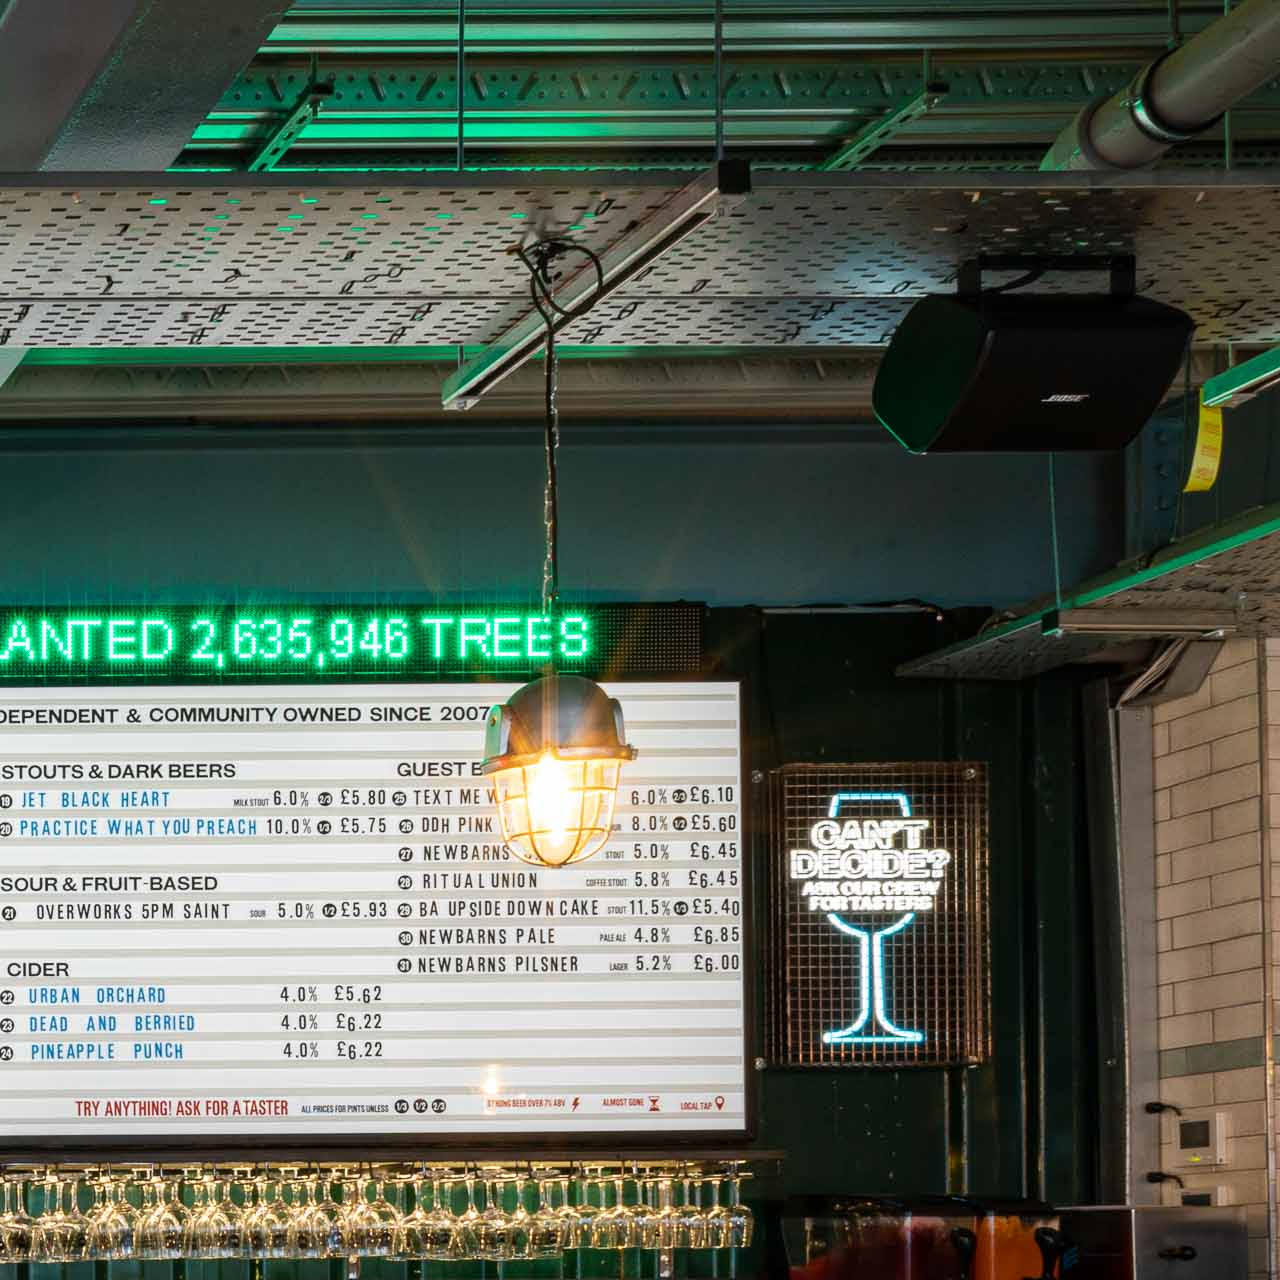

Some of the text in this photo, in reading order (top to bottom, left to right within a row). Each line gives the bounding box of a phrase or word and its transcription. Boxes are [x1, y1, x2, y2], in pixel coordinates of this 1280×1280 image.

[190, 617, 409, 668] 2,635,946
[422, 616, 589, 658] TREES
[126, 709, 141, 723] &
[150, 708, 277, 722] COMMUNITY
[283, 707, 361, 722] OWNED
[370, 707, 431, 721] SINCE
[2, 764, 235, 779] STOUTS & DARK BEERS
[397, 762, 467, 776] GUEST
[22, 791, 169, 807] JET BLACK HEART
[414, 789, 479, 805] TEXT ME
[20, 819, 256, 836] PRACTICE WHAT YOU PREACH
[422, 817, 492, 833] DDH PINK
[810, 819, 929, 848] CAN'T
[790, 849, 951, 880] DECIDE?
[1, 878, 57, 892] SOUR
[63, 877, 77, 891] &
[424, 873, 536, 888] RITUAL UNION
[37, 902, 386, 919] OVERWORKS 5PM SAINT 5.0% £5.93
[420, 901, 438, 917] BA
[449, 901, 500, 917] UPSIDE
[508, 901, 553, 916] DOWN
[560, 900, 598, 915] CAKE
[630, 900, 670, 915] 11.5%
[693, 898, 739, 916] £5.40
[7, 963, 69, 976] CIDER
[419, 956, 505, 973] NEWBARNS
[516, 956, 577, 972] PILSNER
[29, 987, 165, 1003] URBAN ORCHARD
[32, 1043, 183, 1059] PINEAPPLE PUNCH
[75, 1100, 288, 1116] TRY ANYTHING! ASK FOR A TASTER
